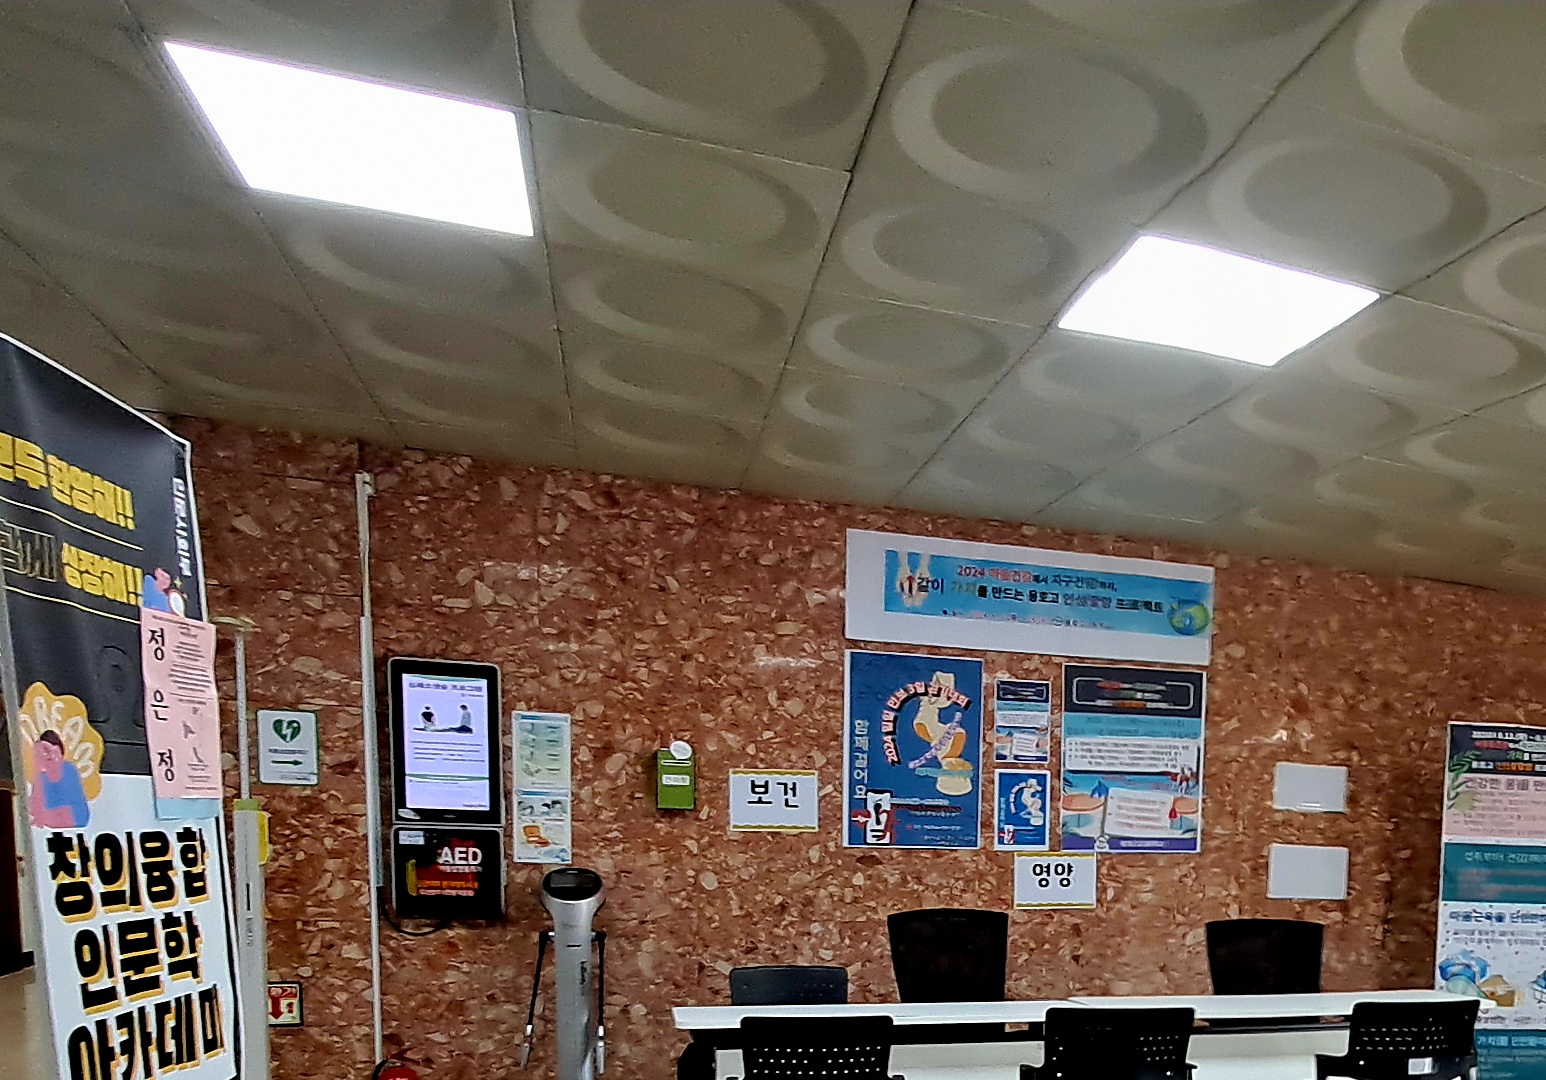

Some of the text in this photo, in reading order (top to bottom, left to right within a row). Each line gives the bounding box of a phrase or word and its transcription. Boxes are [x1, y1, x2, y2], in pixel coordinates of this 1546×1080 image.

[990, 585, 1026, 603] 만드는
[747, 779, 800, 809] 보건
[437, 846, 483, 866] AED
[46, 824, 211, 925] 창의융합
[1032, 862, 1074, 888] 영양
[74, 910, 204, 1017] 인문학
